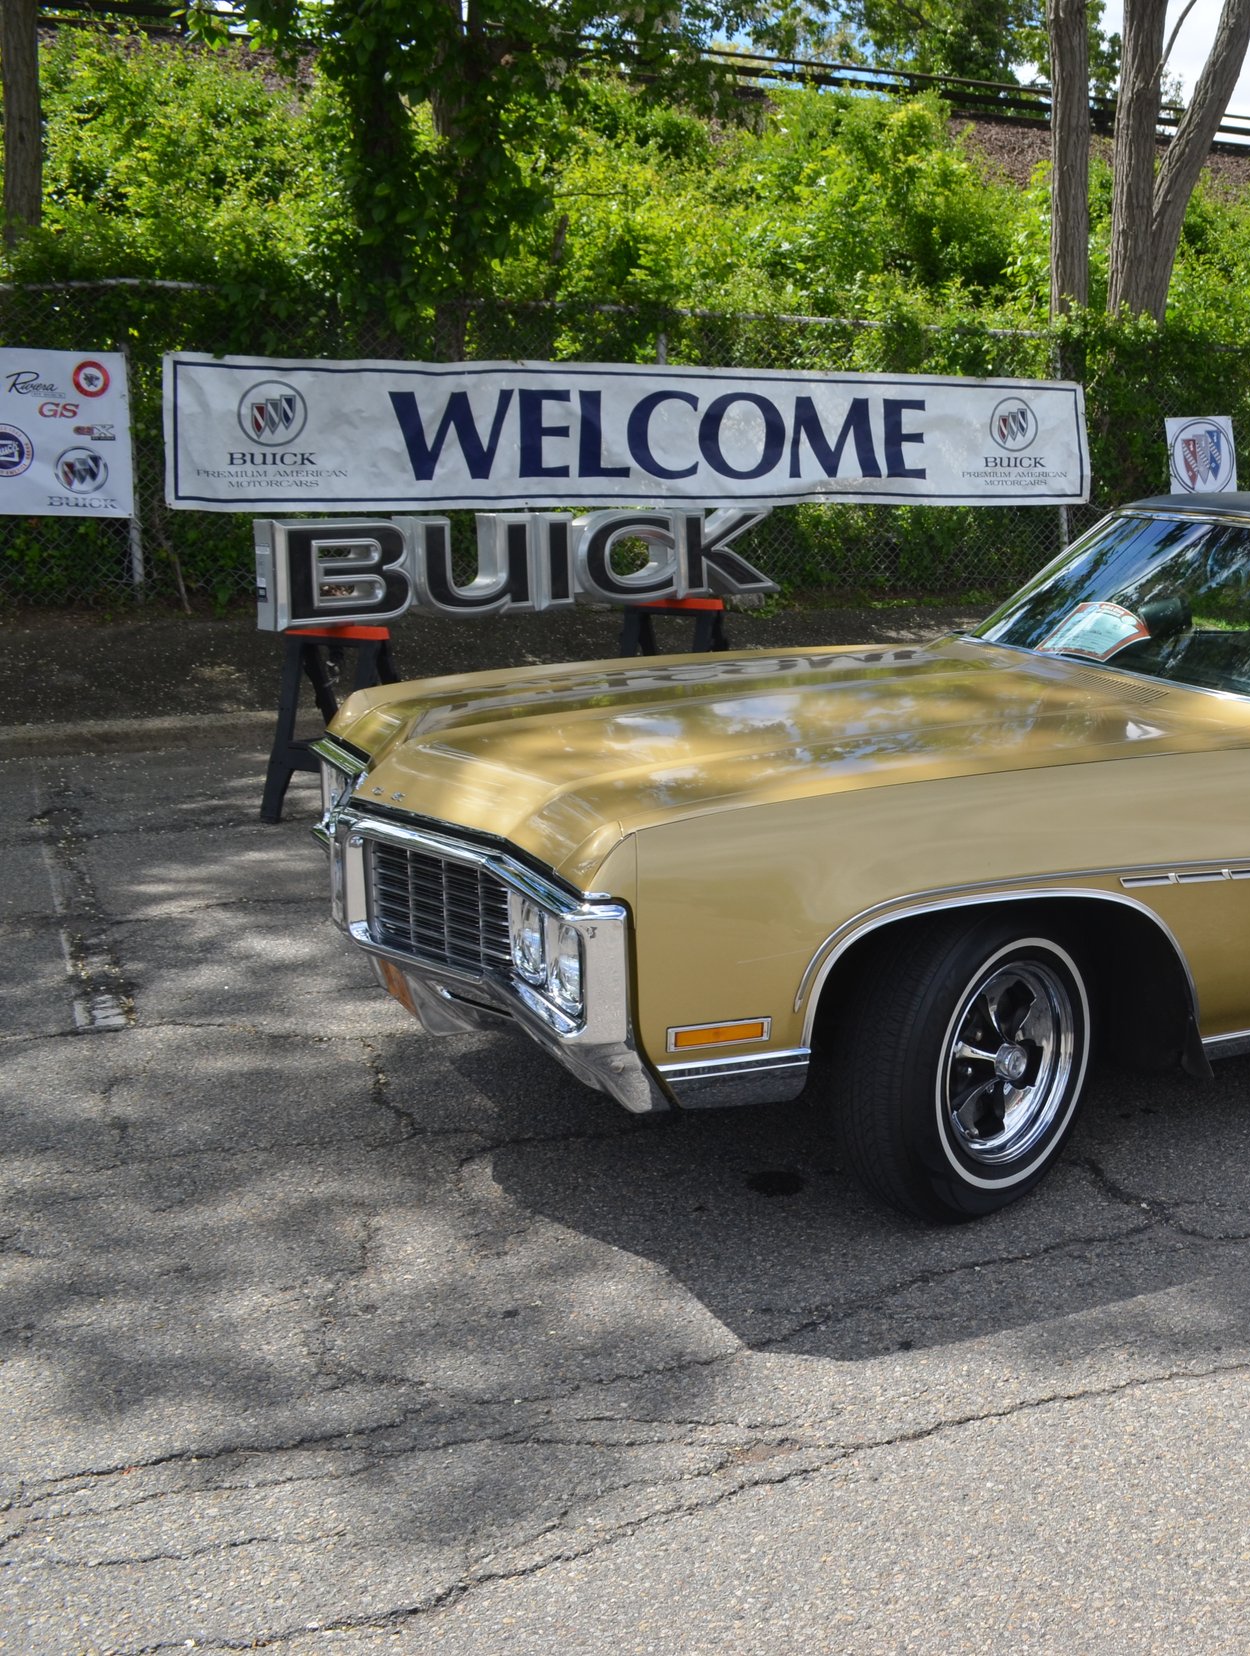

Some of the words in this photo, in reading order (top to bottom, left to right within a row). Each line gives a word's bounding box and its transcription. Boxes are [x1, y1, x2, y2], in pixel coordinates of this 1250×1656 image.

[6, 371, 58, 395] Riviera
[38, 402, 80, 419] GS
[388, 388, 927, 481] WELCOME
[227, 452, 317, 466] BUICK
[984, 456, 1047, 468] BUICK
[196, 469, 268, 478] PREMIUM
[273, 469, 348, 478] AMERICAN
[228, 480, 319, 488] MOTORCARS
[47, 496, 118, 509] BUICK
[254, 507, 781, 632] BUICK
